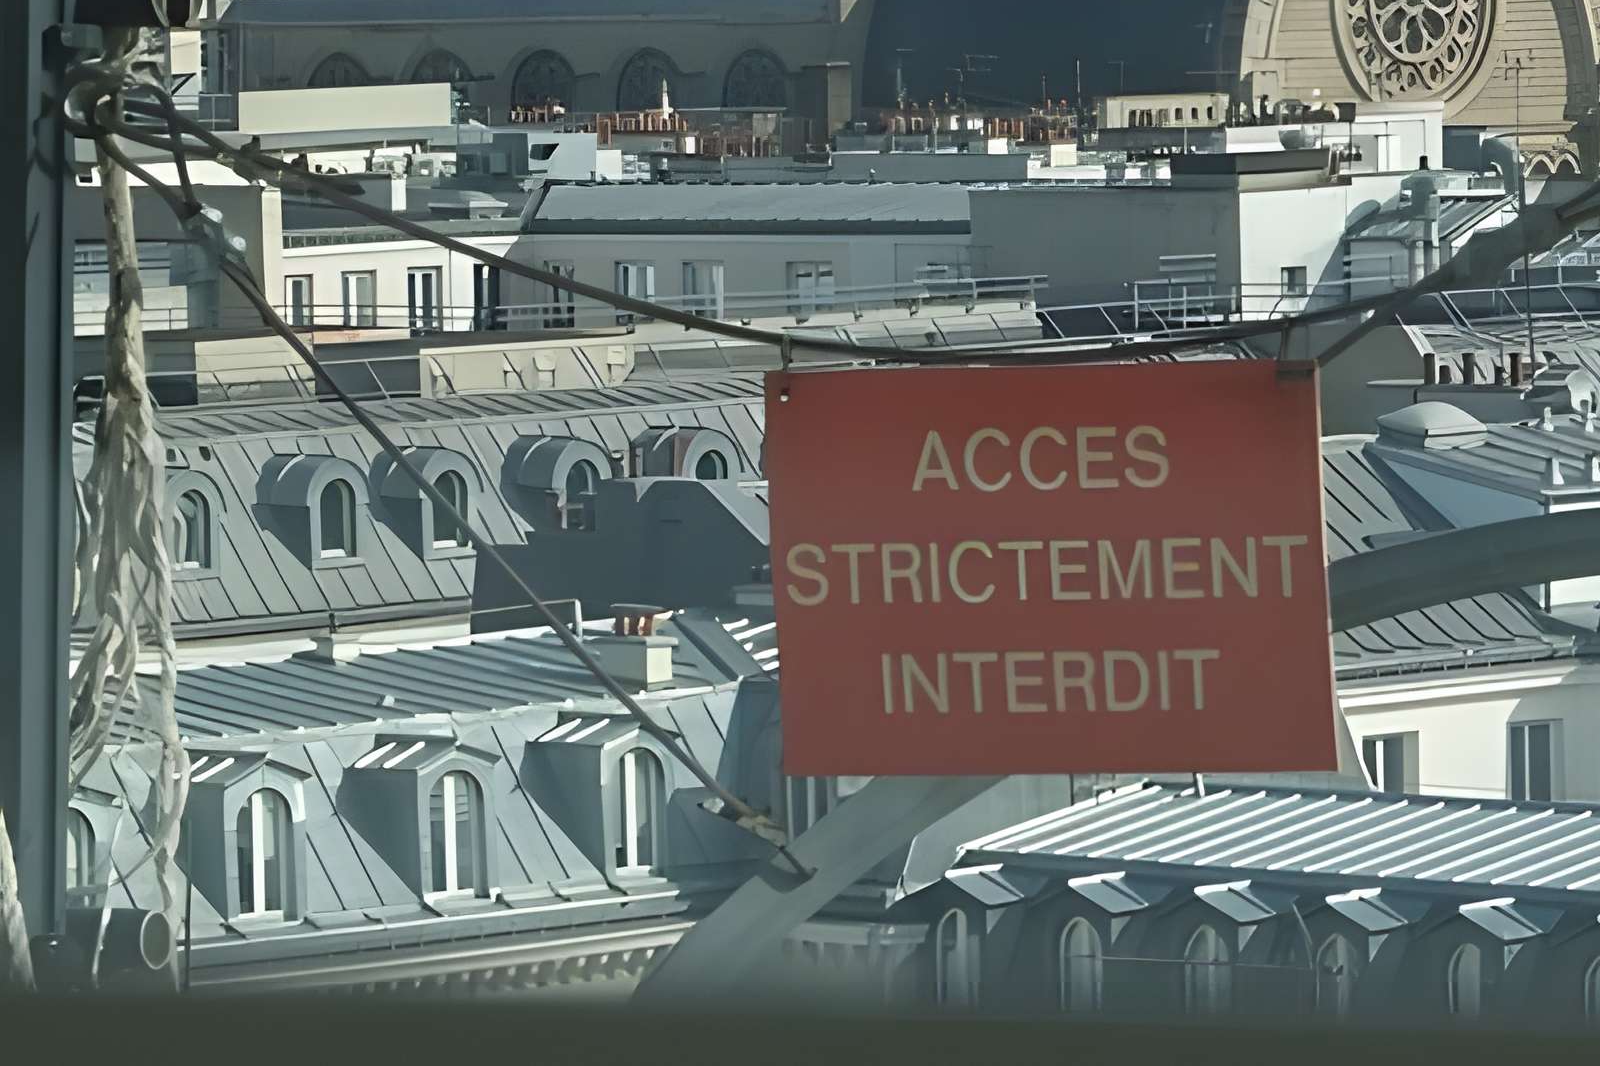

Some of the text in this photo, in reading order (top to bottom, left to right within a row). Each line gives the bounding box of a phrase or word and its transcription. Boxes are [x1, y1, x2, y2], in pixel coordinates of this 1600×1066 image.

[912, 425, 1170, 492] ACCES
[786, 535, 1308, 606] STRICTEMENT
[880, 648, 1220, 714] INTERDIT
